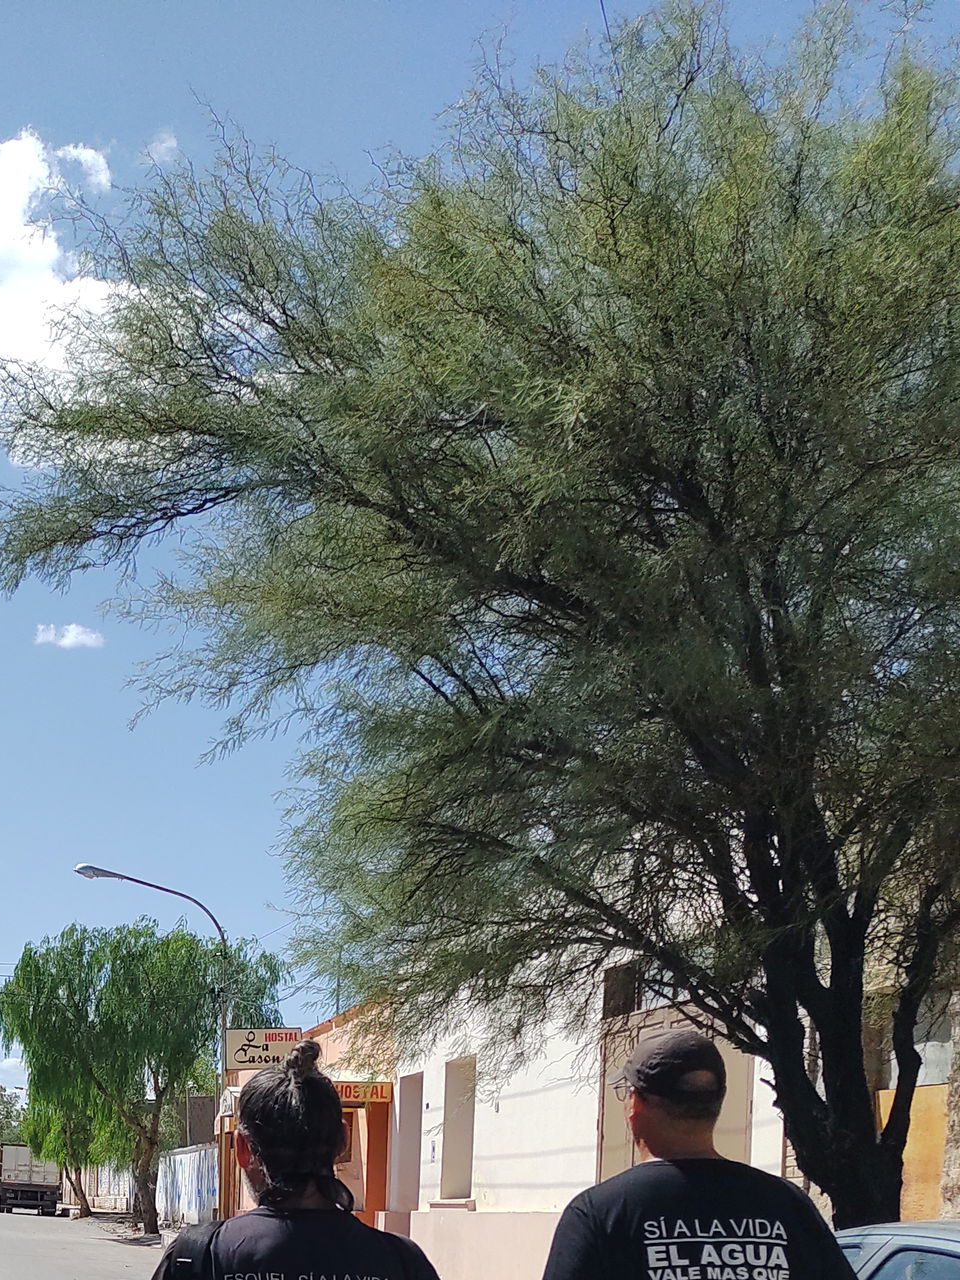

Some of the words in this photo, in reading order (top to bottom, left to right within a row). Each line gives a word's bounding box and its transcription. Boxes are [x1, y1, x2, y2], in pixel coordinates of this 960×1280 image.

[264, 1031, 299, 1042] HOSTAL
[234, 1047, 284, 1064] Cason
[643, 1217, 667, 1238] SÍ
[674, 1219, 691, 1237] A
[695, 1219, 726, 1237] LA
[729, 1219, 787, 1239] VIDA
[647, 1245, 689, 1267] EL
[701, 1244, 789, 1268] AGUA
[707, 1267, 749, 1280] MAS
